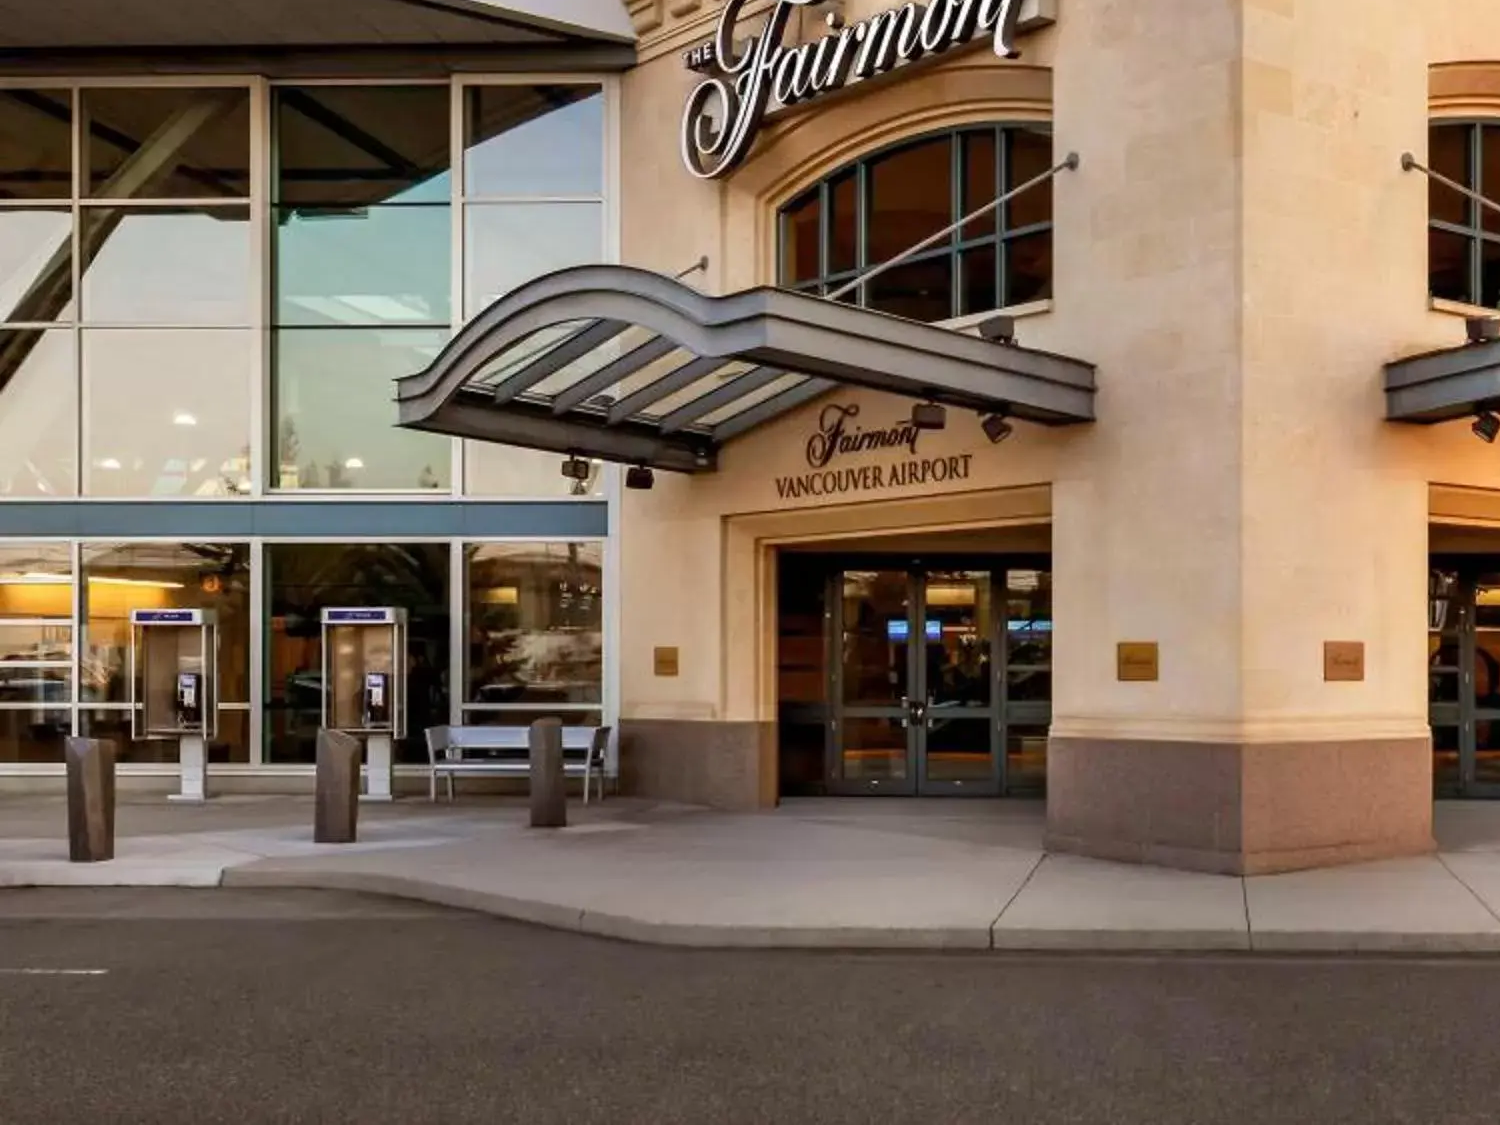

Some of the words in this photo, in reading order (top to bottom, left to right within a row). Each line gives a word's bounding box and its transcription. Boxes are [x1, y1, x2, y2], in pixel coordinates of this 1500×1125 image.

[681, 42, 712, 66] THE
[806, 403, 922, 468] Fairmont
[776, 466, 884, 500] VANCOUVER
[889, 455, 973, 487] AIRPORT
